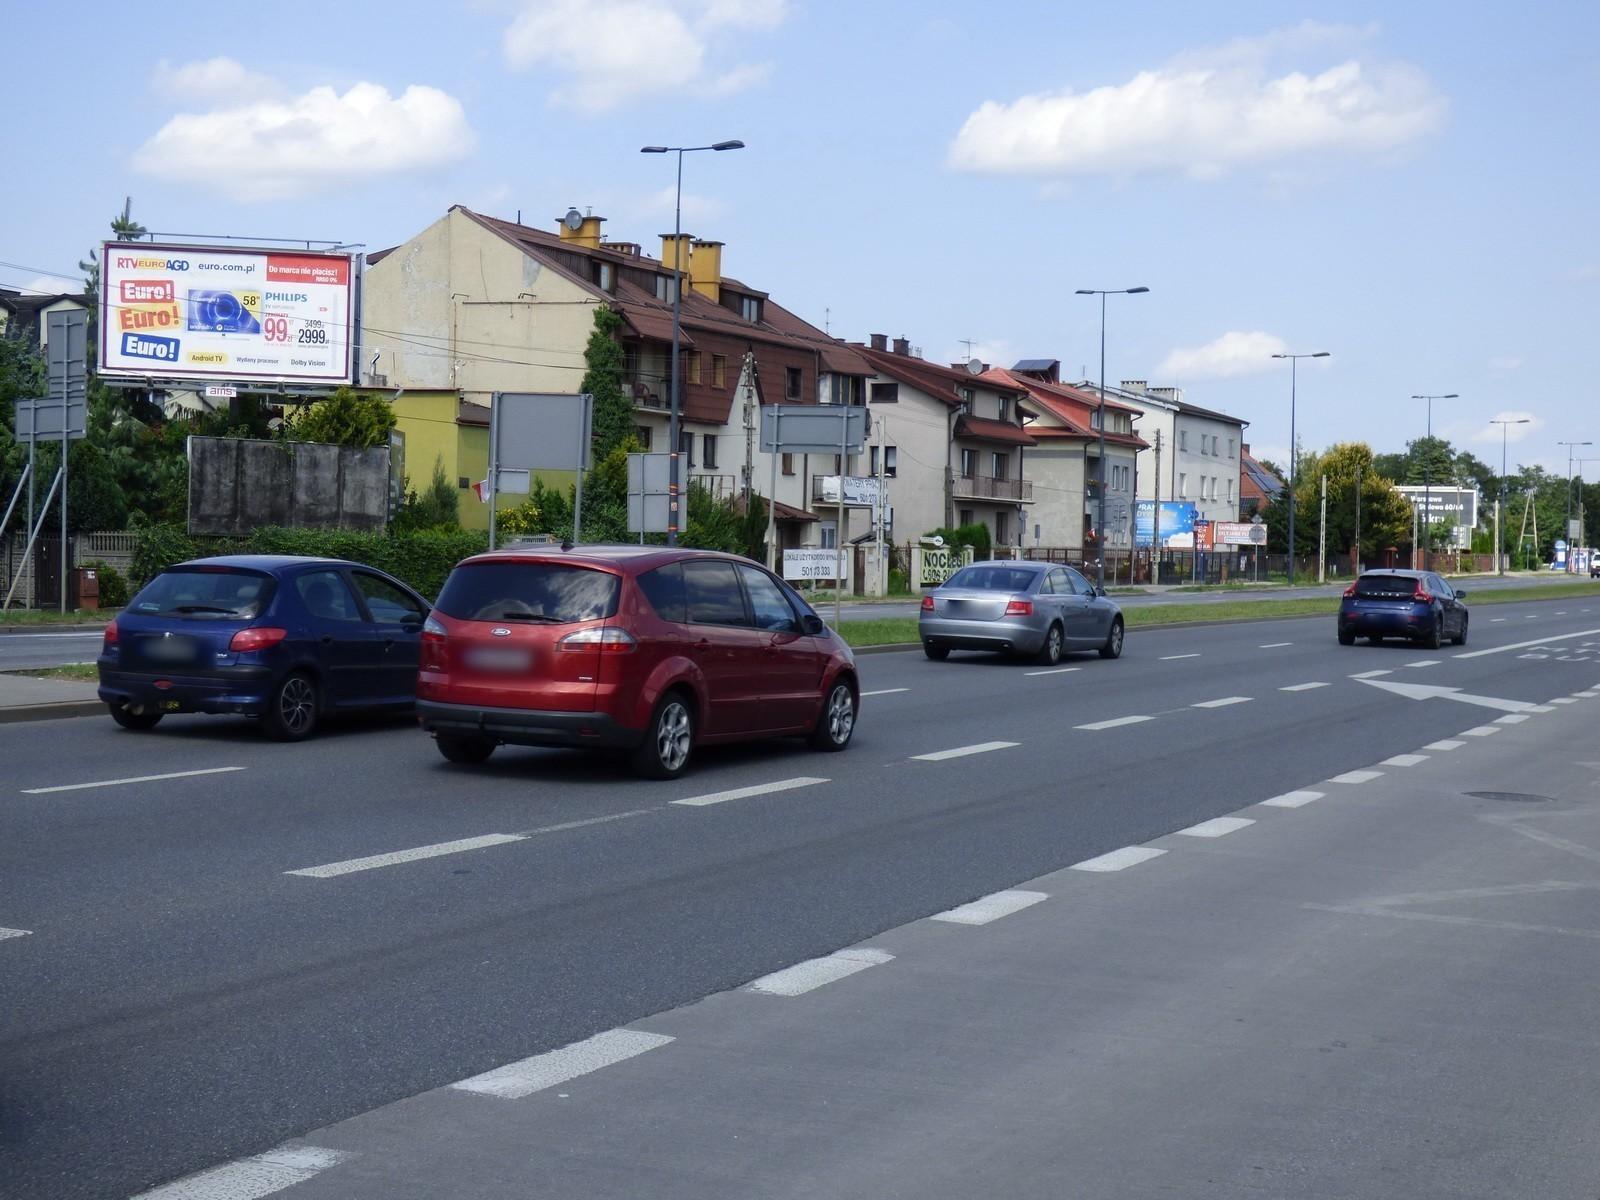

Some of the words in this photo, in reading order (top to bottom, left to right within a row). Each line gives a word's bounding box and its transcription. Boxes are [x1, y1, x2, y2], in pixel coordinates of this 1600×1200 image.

[198, 263, 256, 274] euro.com.pl
[269, 265, 278, 273] Do
[279, 266, 300, 275] marca
[301, 267, 311, 275] nie
[124, 282, 172, 300] Euro!
[265, 291, 308, 302] PHILIPS
[120, 306, 180, 330] Euro!
[264, 317, 288, 342] 99
[304, 319, 321, 329] 3499
[298, 328, 325, 344] 2999
[126, 336, 176, 359] Euro!
[191, 354, 214, 362] Android
[290, 359, 307, 367] Dolby
[1410, 495, 1443, 503] Warsawa
